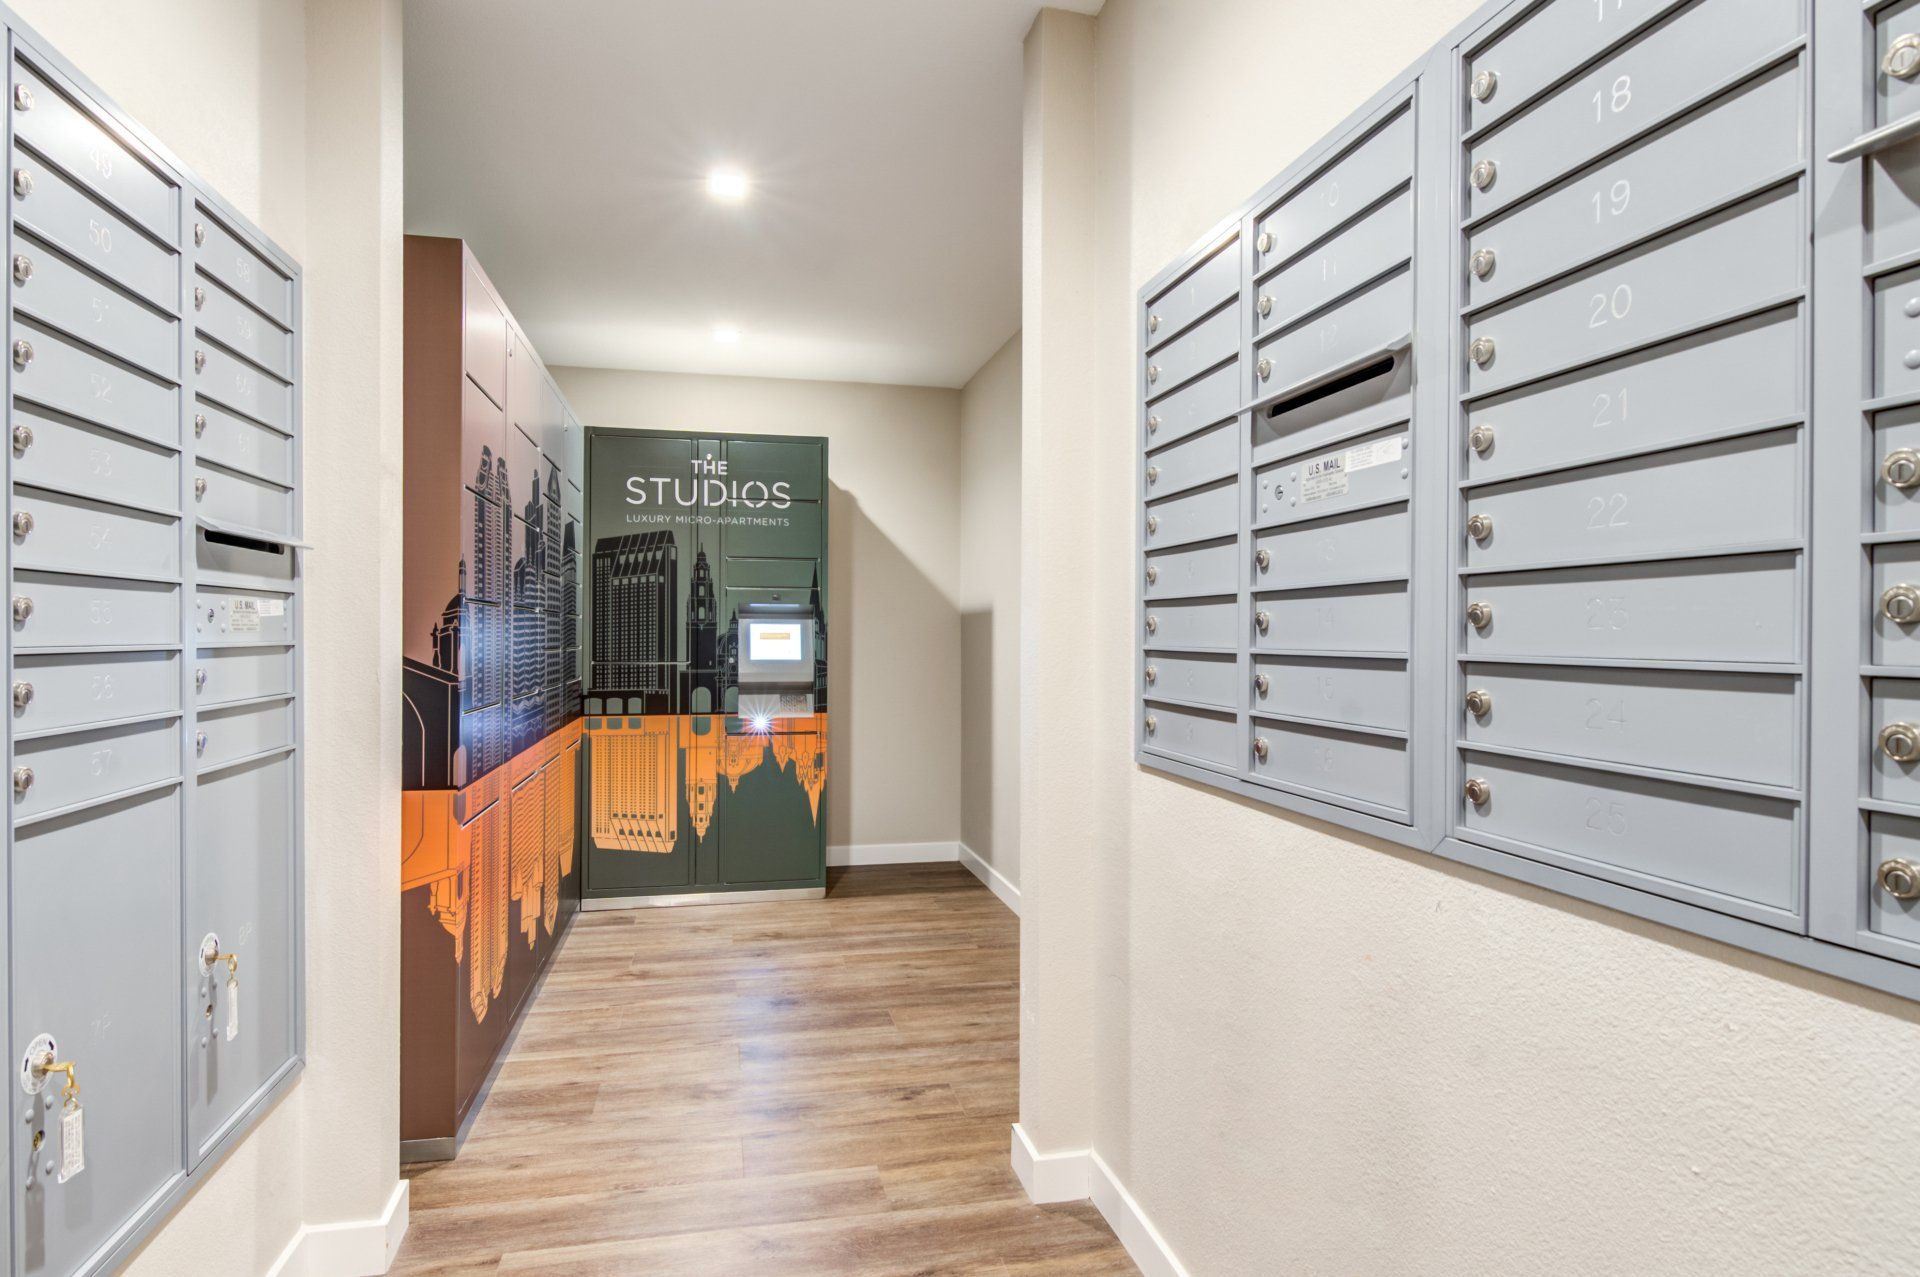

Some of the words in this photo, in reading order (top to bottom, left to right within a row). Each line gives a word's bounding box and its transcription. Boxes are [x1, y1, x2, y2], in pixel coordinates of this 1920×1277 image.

[1593, 75, 1632, 124] 18
[1592, 179, 1632, 224] 19
[89, 218, 113, 253] 50
[1589, 284, 1632, 328] 20
[89, 373, 113, 404] 52
[1592, 387, 1628, 428] 21
[90, 448, 113, 478] 53
[691, 459, 728, 475] THE
[1323, 457, 1341, 471] MAIL
[626, 476, 791, 509] STUDIOS
[626, 514, 671, 524] LUXURY
[675, 515, 790, 527] MICRO-APARTMENTS
[1587, 493, 1629, 530] 22
[90, 525, 113, 550] 54
[1585, 698, 1628, 732] 24
[1585, 798, 1627, 836] 25
